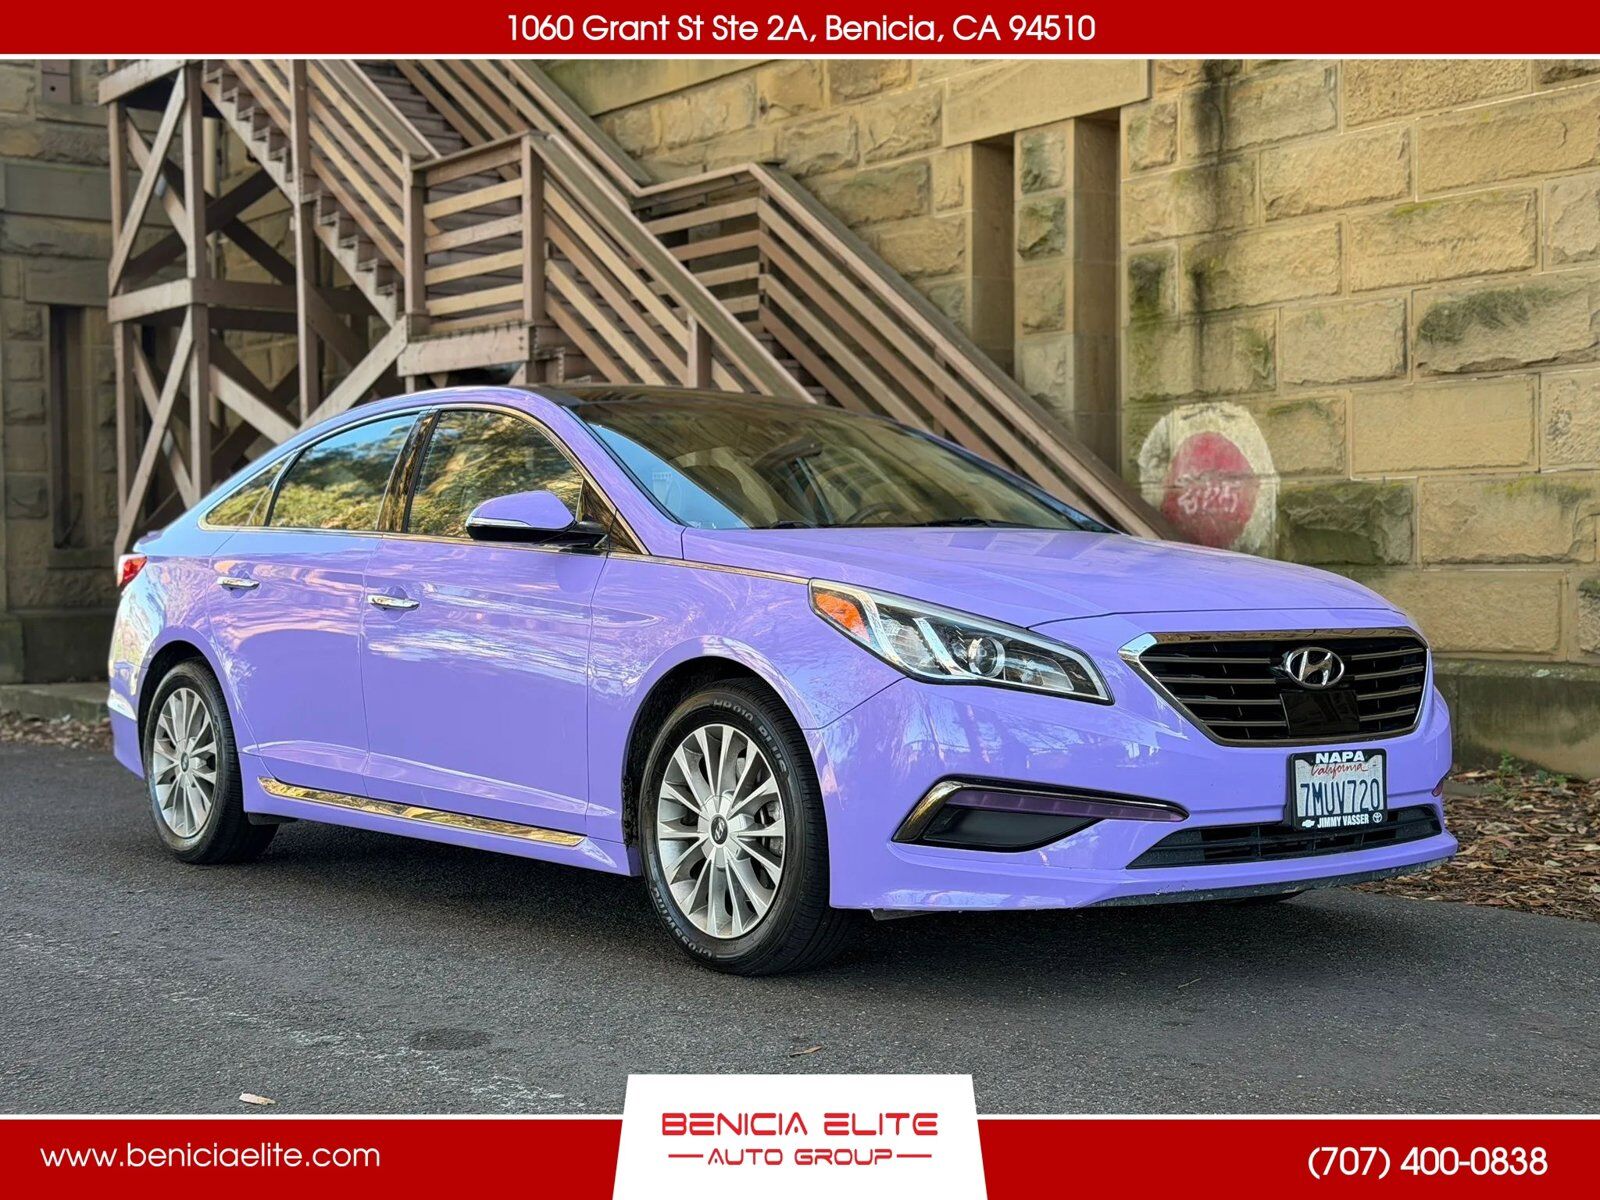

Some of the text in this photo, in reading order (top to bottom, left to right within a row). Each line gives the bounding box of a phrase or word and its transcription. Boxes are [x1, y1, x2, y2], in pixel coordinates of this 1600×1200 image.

[1315, 750, 1365, 764] NAPA
[1311, 762, 1368, 779] California
[1300, 778, 1380, 816] 7MUV720
[1317, 813, 1370, 829] JIMMY VASSER
